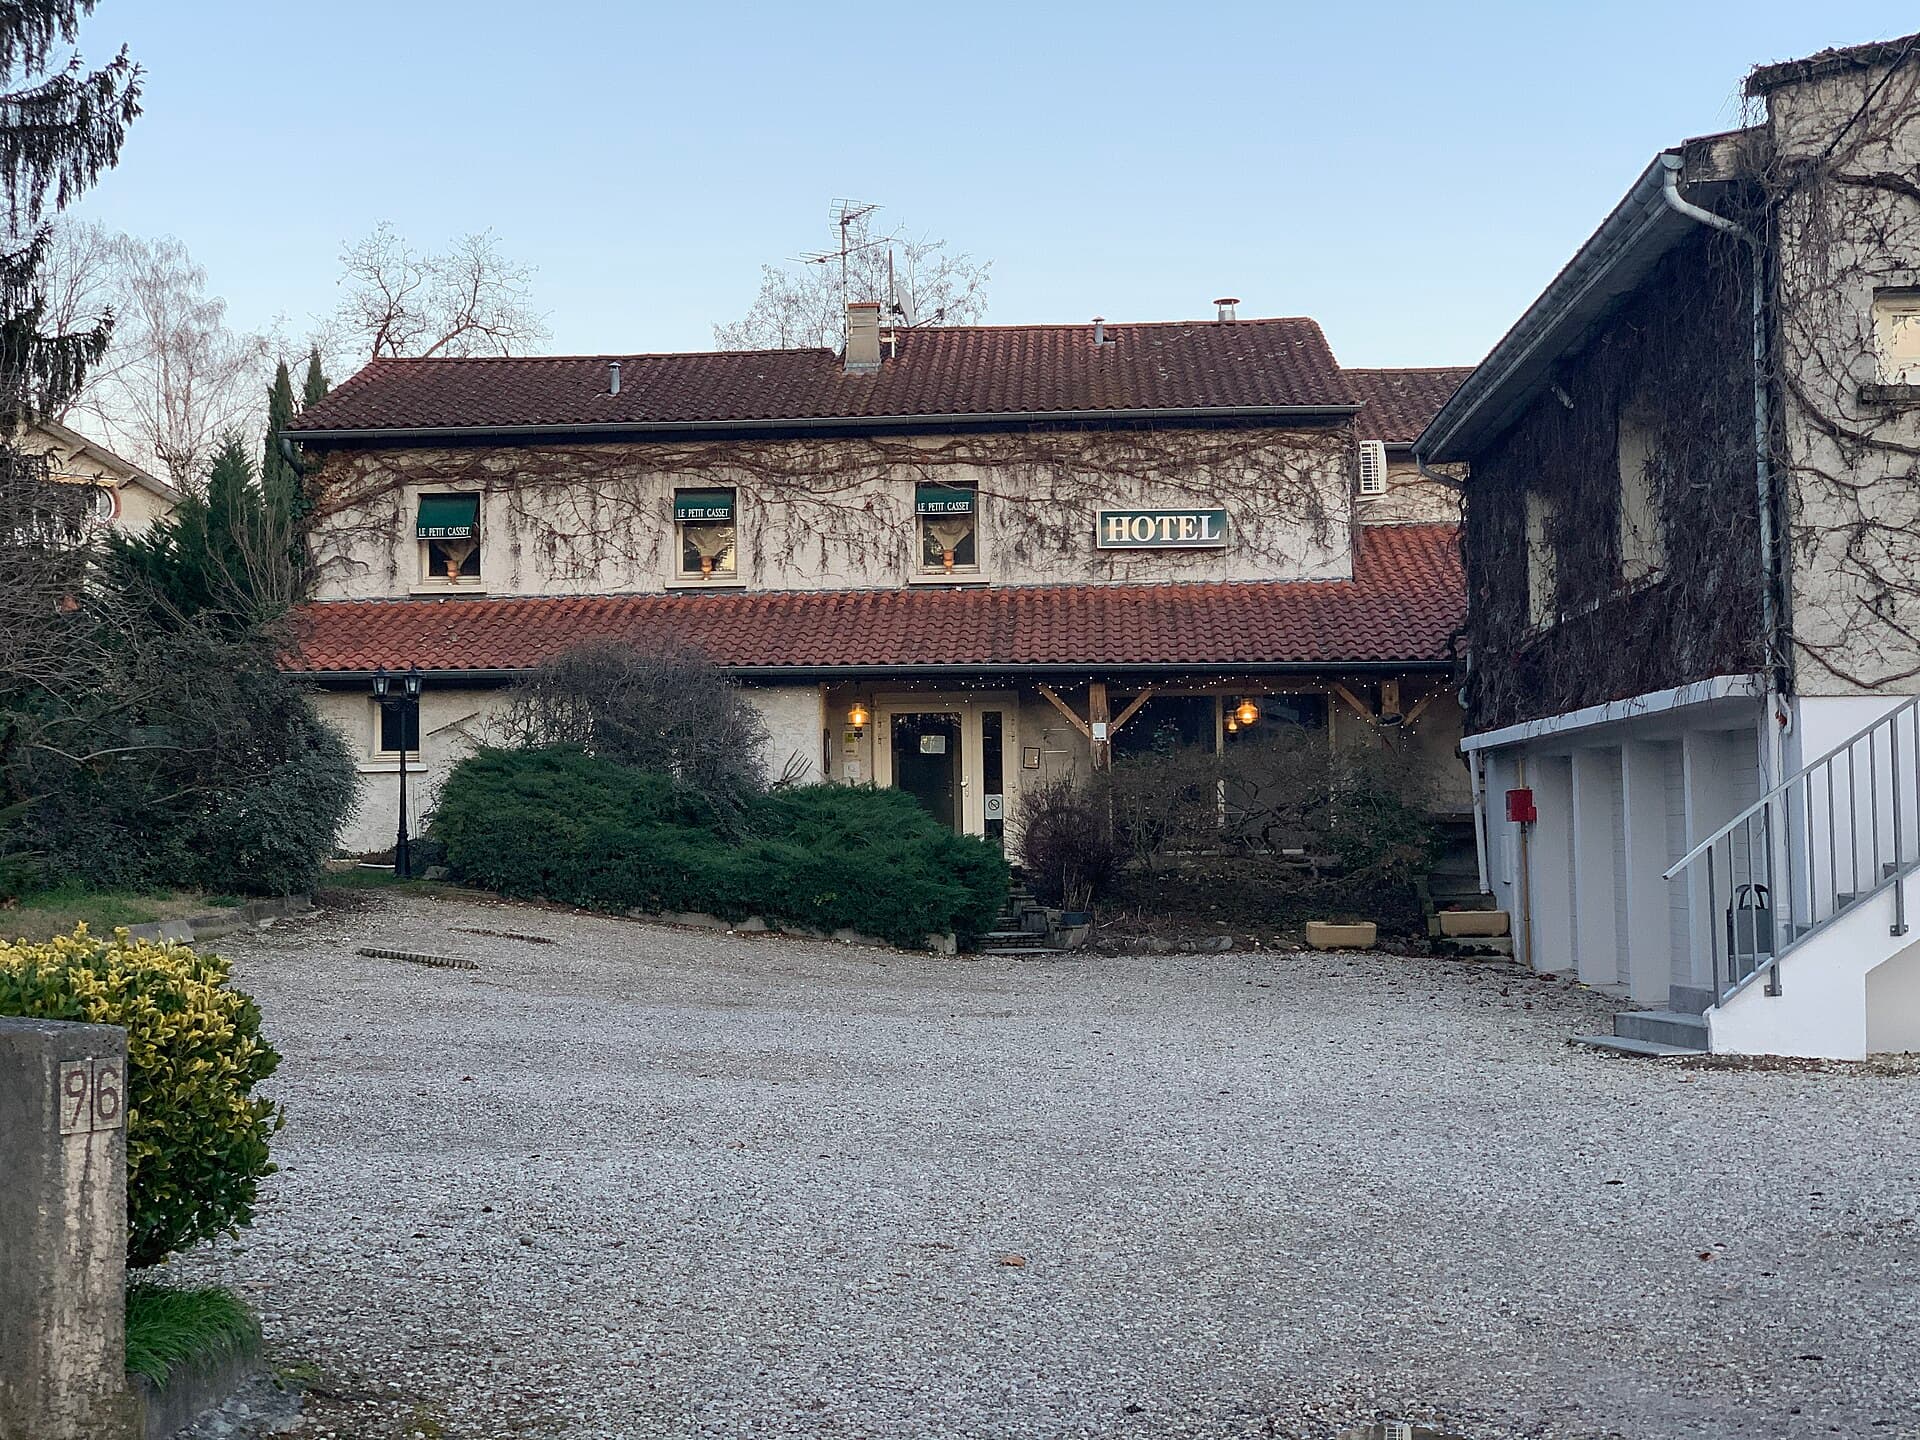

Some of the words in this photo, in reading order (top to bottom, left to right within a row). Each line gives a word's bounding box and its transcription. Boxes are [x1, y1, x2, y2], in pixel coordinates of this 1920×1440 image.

[918, 502, 926, 512] LE
[928, 502, 944, 512] PETIT
[947, 501, 969, 511] CASSET
[677, 508, 686, 518] LE
[688, 508, 704, 518] PETIT
[706, 508, 729, 517] CASSET
[418, 527, 426, 537] LE
[428, 527, 445, 537] PETIT
[447, 526, 470, 536] CASSET
[1106, 515, 1221, 542] HOTEL
[64, 1068, 119, 1127] 96
